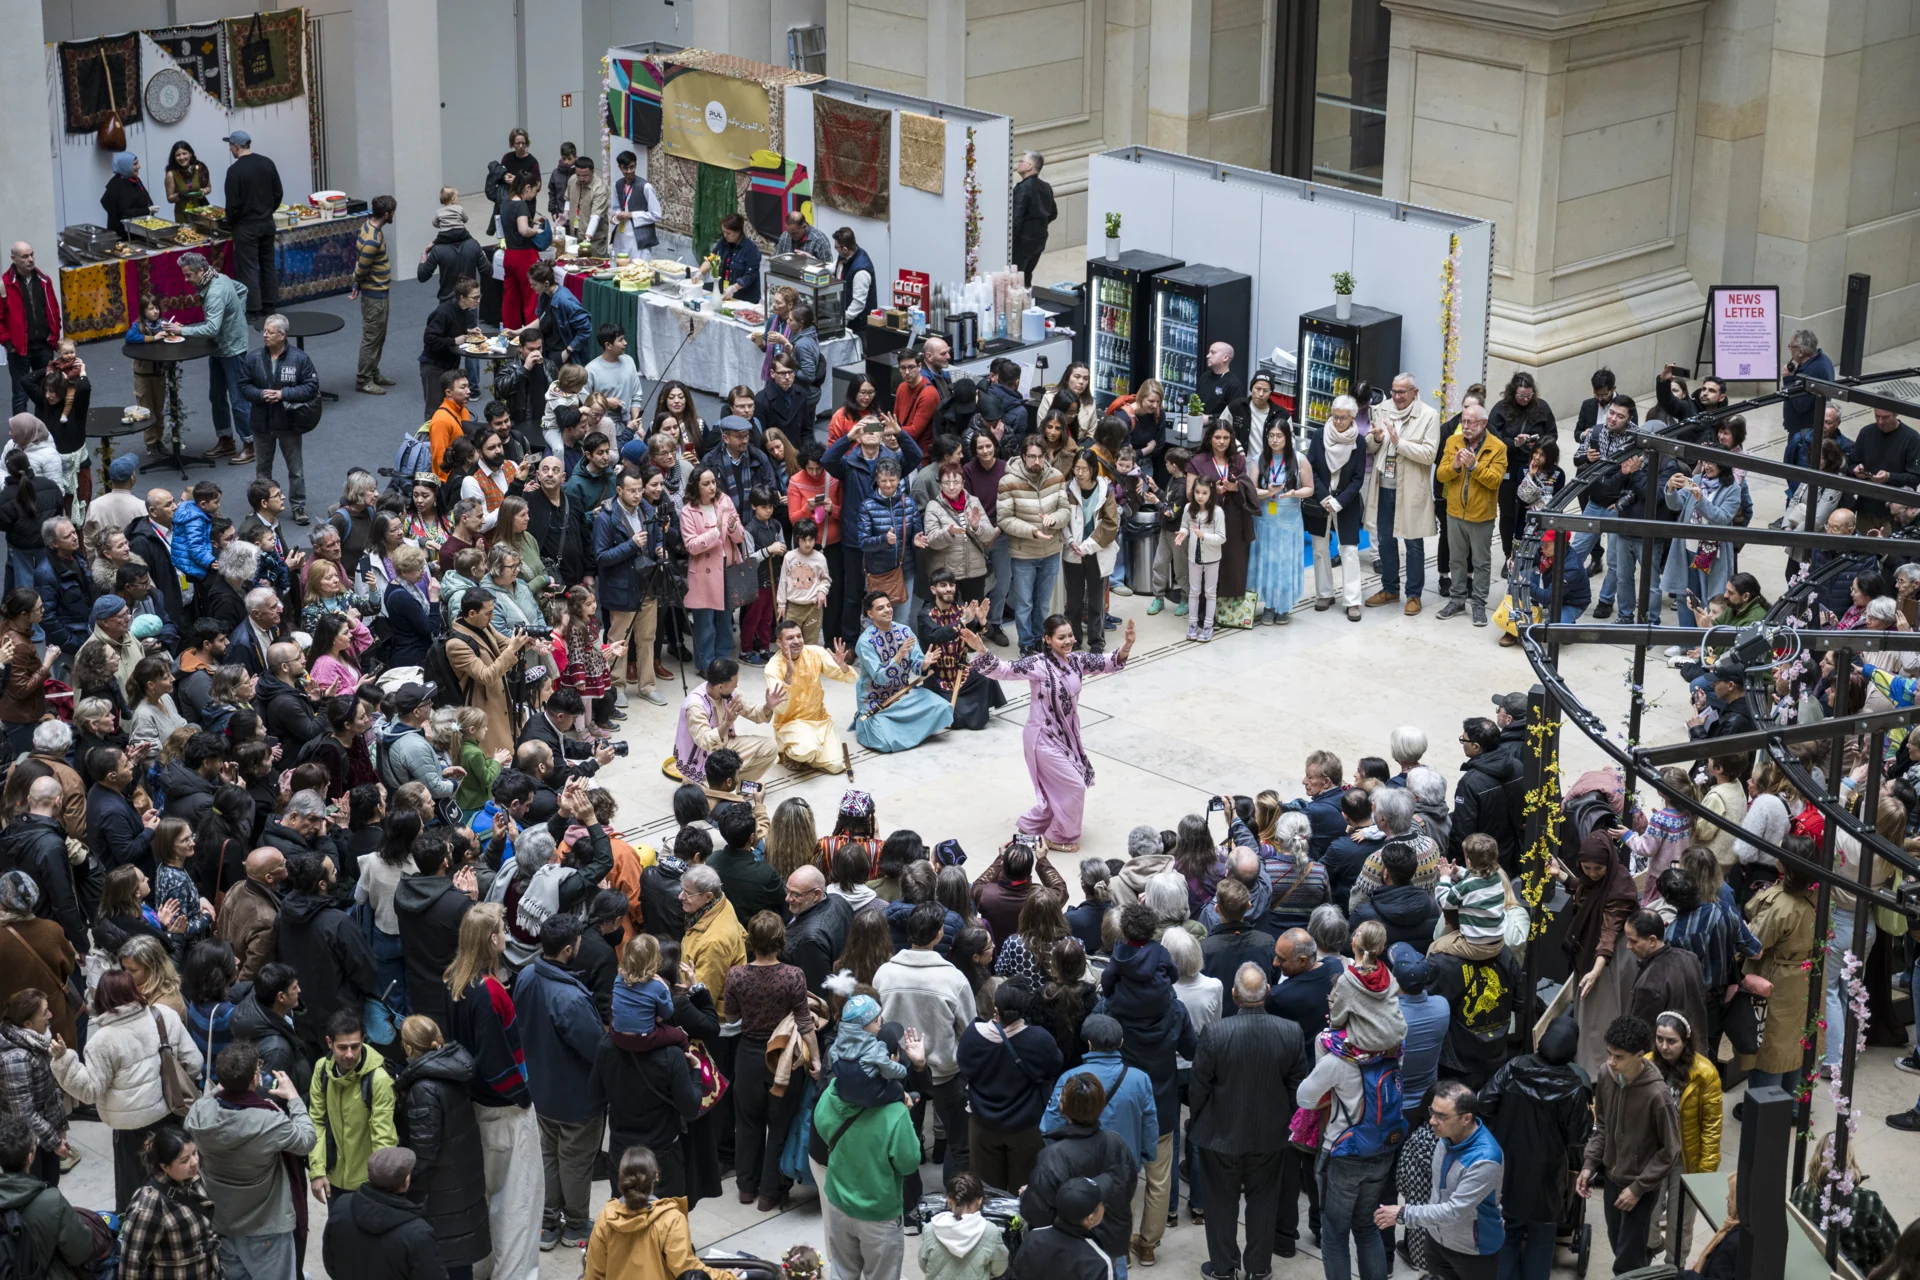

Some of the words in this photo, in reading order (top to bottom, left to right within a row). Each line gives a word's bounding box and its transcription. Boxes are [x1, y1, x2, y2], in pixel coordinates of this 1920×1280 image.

[709, 110, 722, 119] PUL
[1728, 294, 1761, 305] NEWS
[1725, 307, 1765, 318] LETTER
